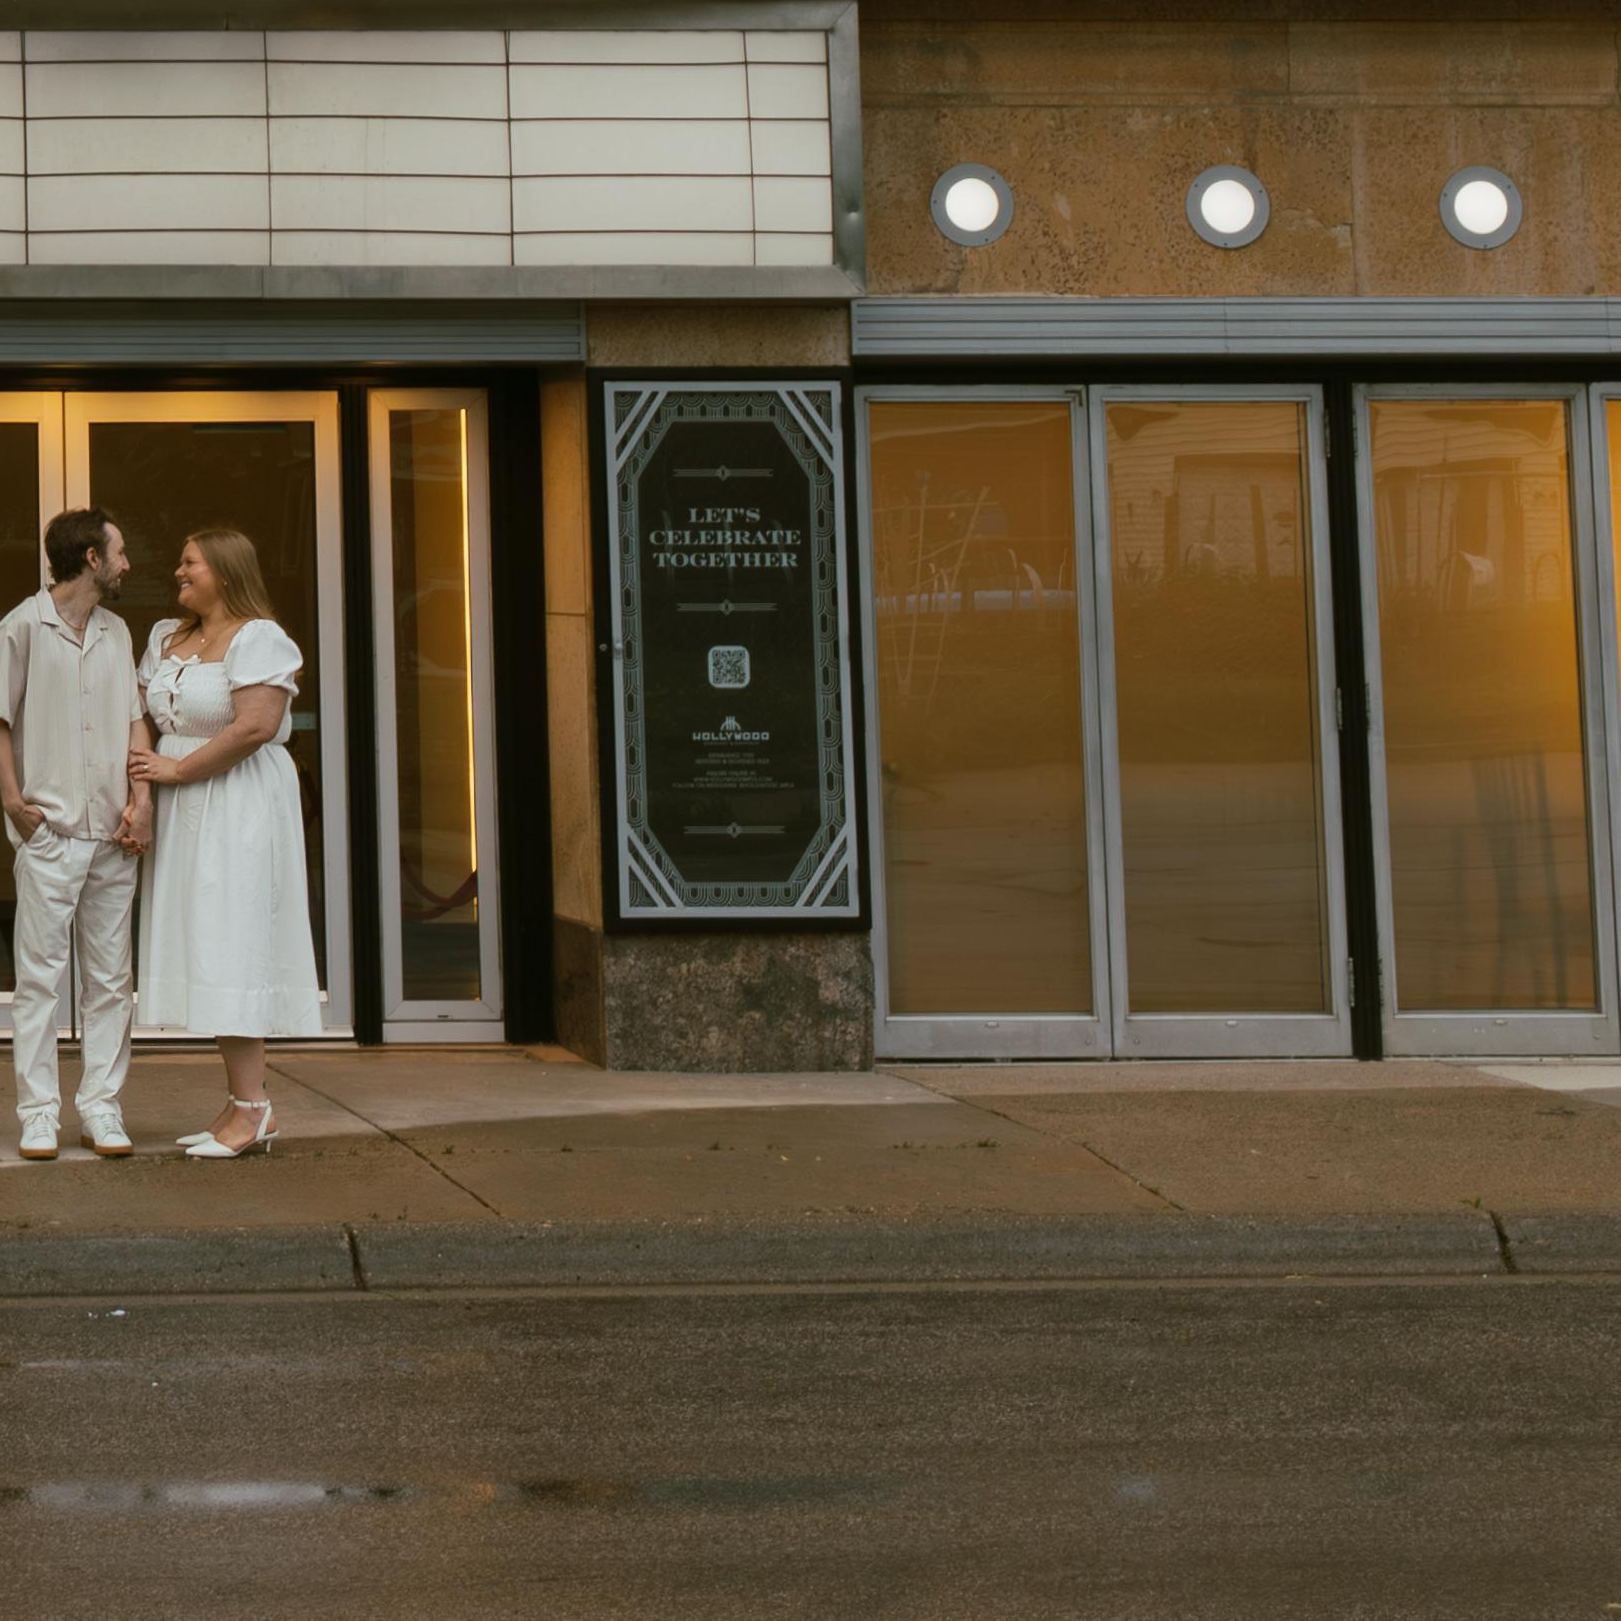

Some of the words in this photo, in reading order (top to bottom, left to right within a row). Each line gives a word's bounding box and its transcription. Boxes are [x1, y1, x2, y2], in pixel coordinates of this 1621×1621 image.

[688, 507, 761, 523] LET'S
[649, 529, 802, 547] CELEBRATE
[653, 552, 798, 568] TOGETHER
[692, 732, 770, 741] HOLLYWOOD
